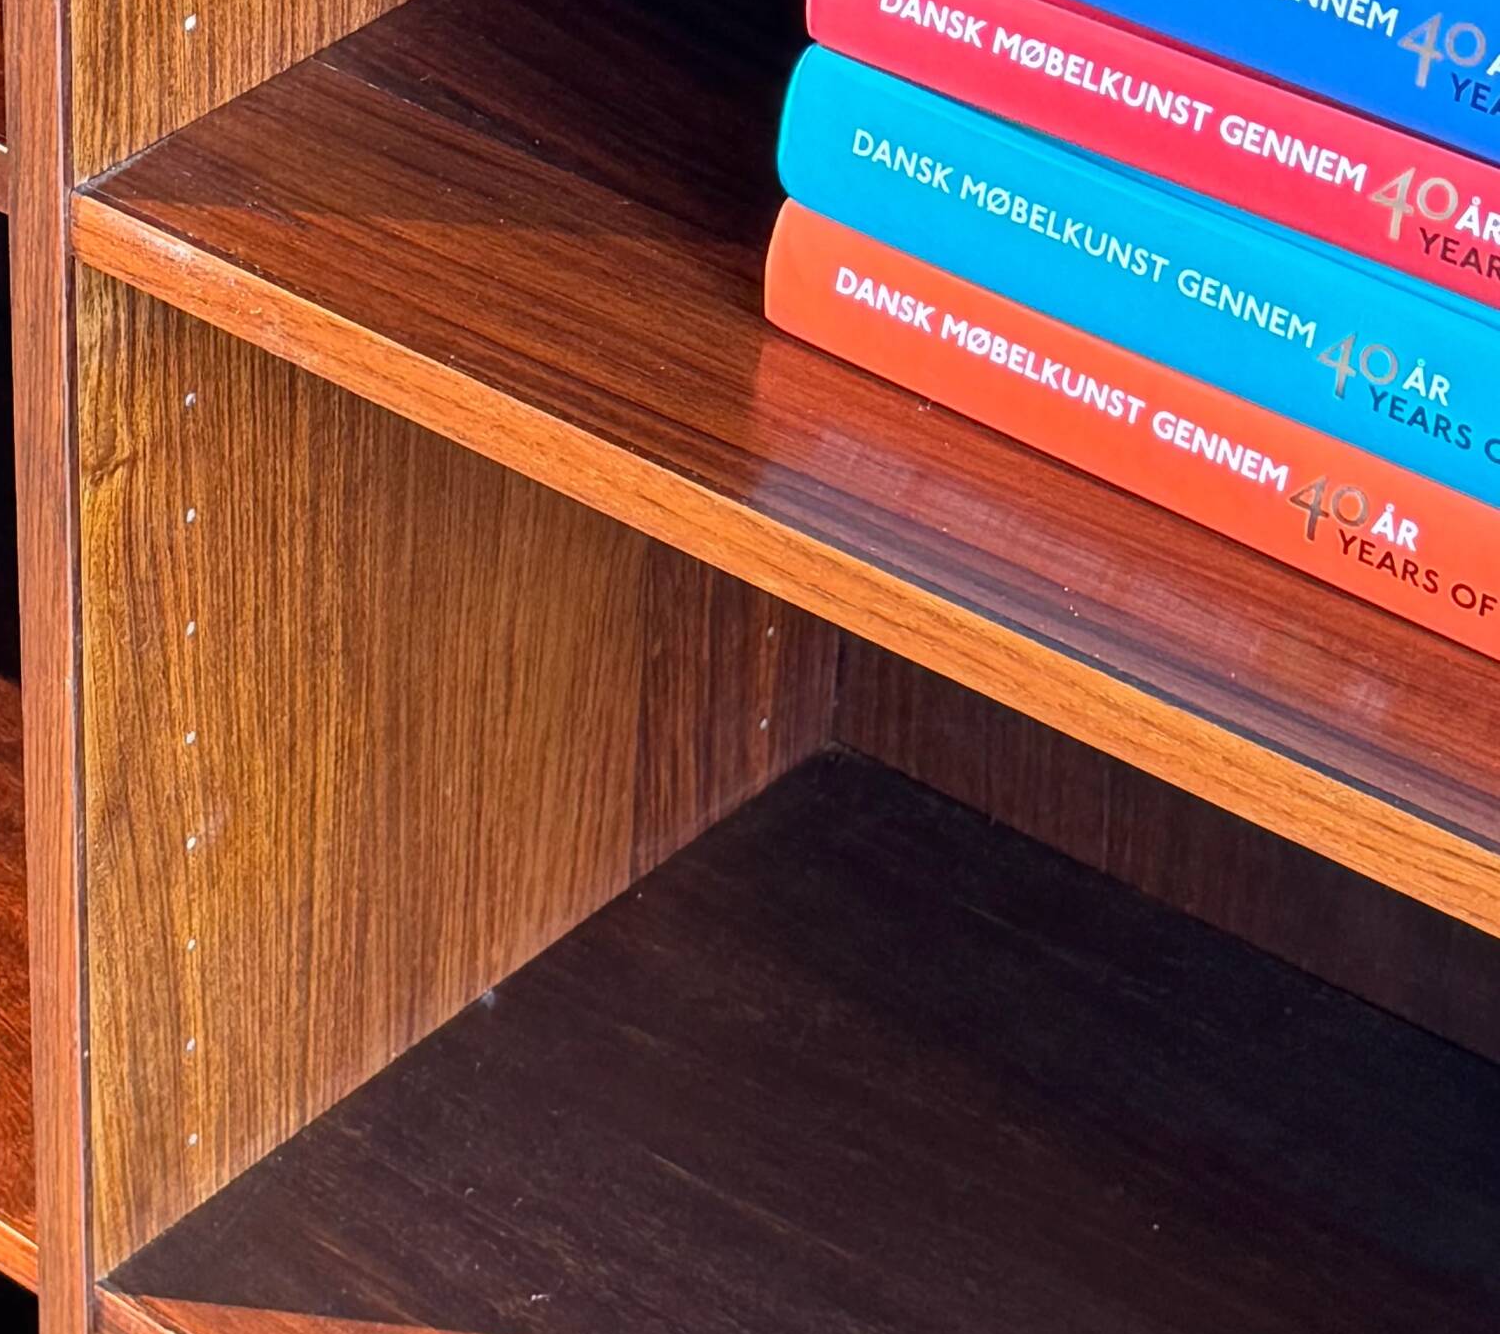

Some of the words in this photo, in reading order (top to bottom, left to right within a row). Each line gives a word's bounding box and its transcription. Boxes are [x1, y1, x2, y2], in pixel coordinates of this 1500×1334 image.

[1398, 13, 1486, 88] 40
[992, 26, 1214, 132] MØBELKUNST
[1219, 114, 1367, 193] GENNEM
[1368, 167, 1458, 241] 40
[852, 129, 954, 194] DANSK
[959, 174, 1169, 283] MØBELKUNST
[1177, 268, 1317, 348] GENNEM
[1316, 330, 1398, 399] 40
[1402, 358, 1450, 406] ÅR
[835, 266, 937, 333] DANSK
[941, 313, 1146, 425] MØBELKUNST
[1151, 410, 1290, 492] GENNEM
[1288, 476, 1369, 541] 40
[1371, 503, 1419, 552] ÅR
[1369, 385, 1472, 450] YEARS
[1339, 529, 1439, 594] YEARS
[1451, 583, 1498, 617] OF
